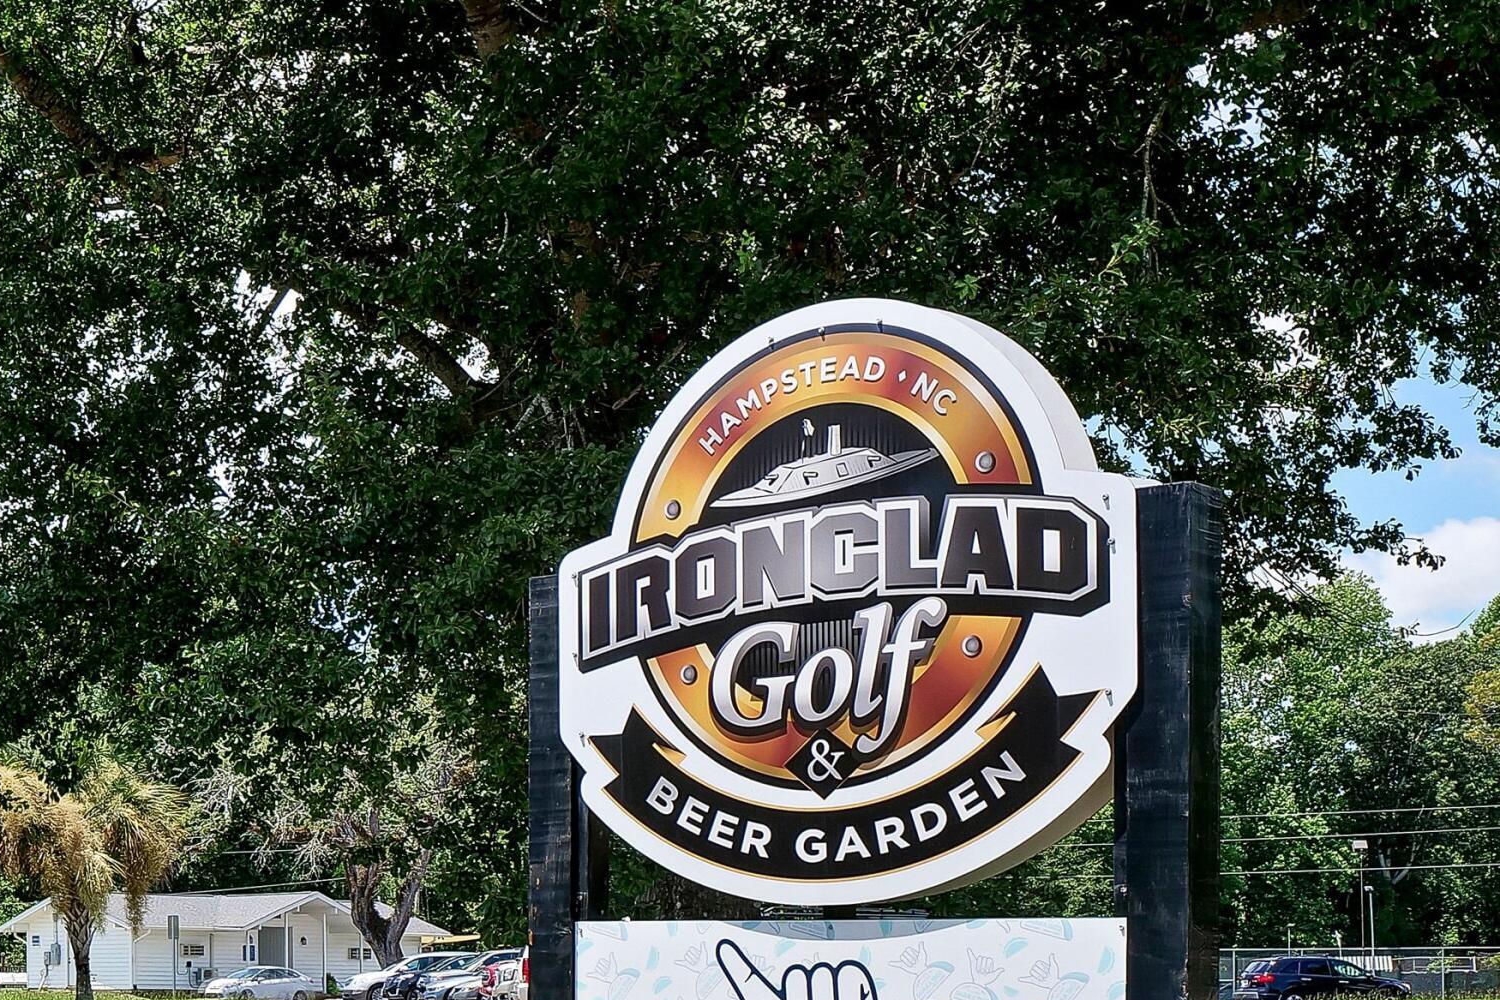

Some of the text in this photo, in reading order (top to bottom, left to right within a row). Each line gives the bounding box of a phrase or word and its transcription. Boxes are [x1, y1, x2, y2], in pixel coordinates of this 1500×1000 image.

[697, 355, 958, 456] HAMPSTEAD NC
[579, 497, 1101, 661] IRONCLAD
[711, 598, 947, 754] Golf
[646, 750, 1027, 863] BEER GARDEN
[806, 738, 843, 781] &
